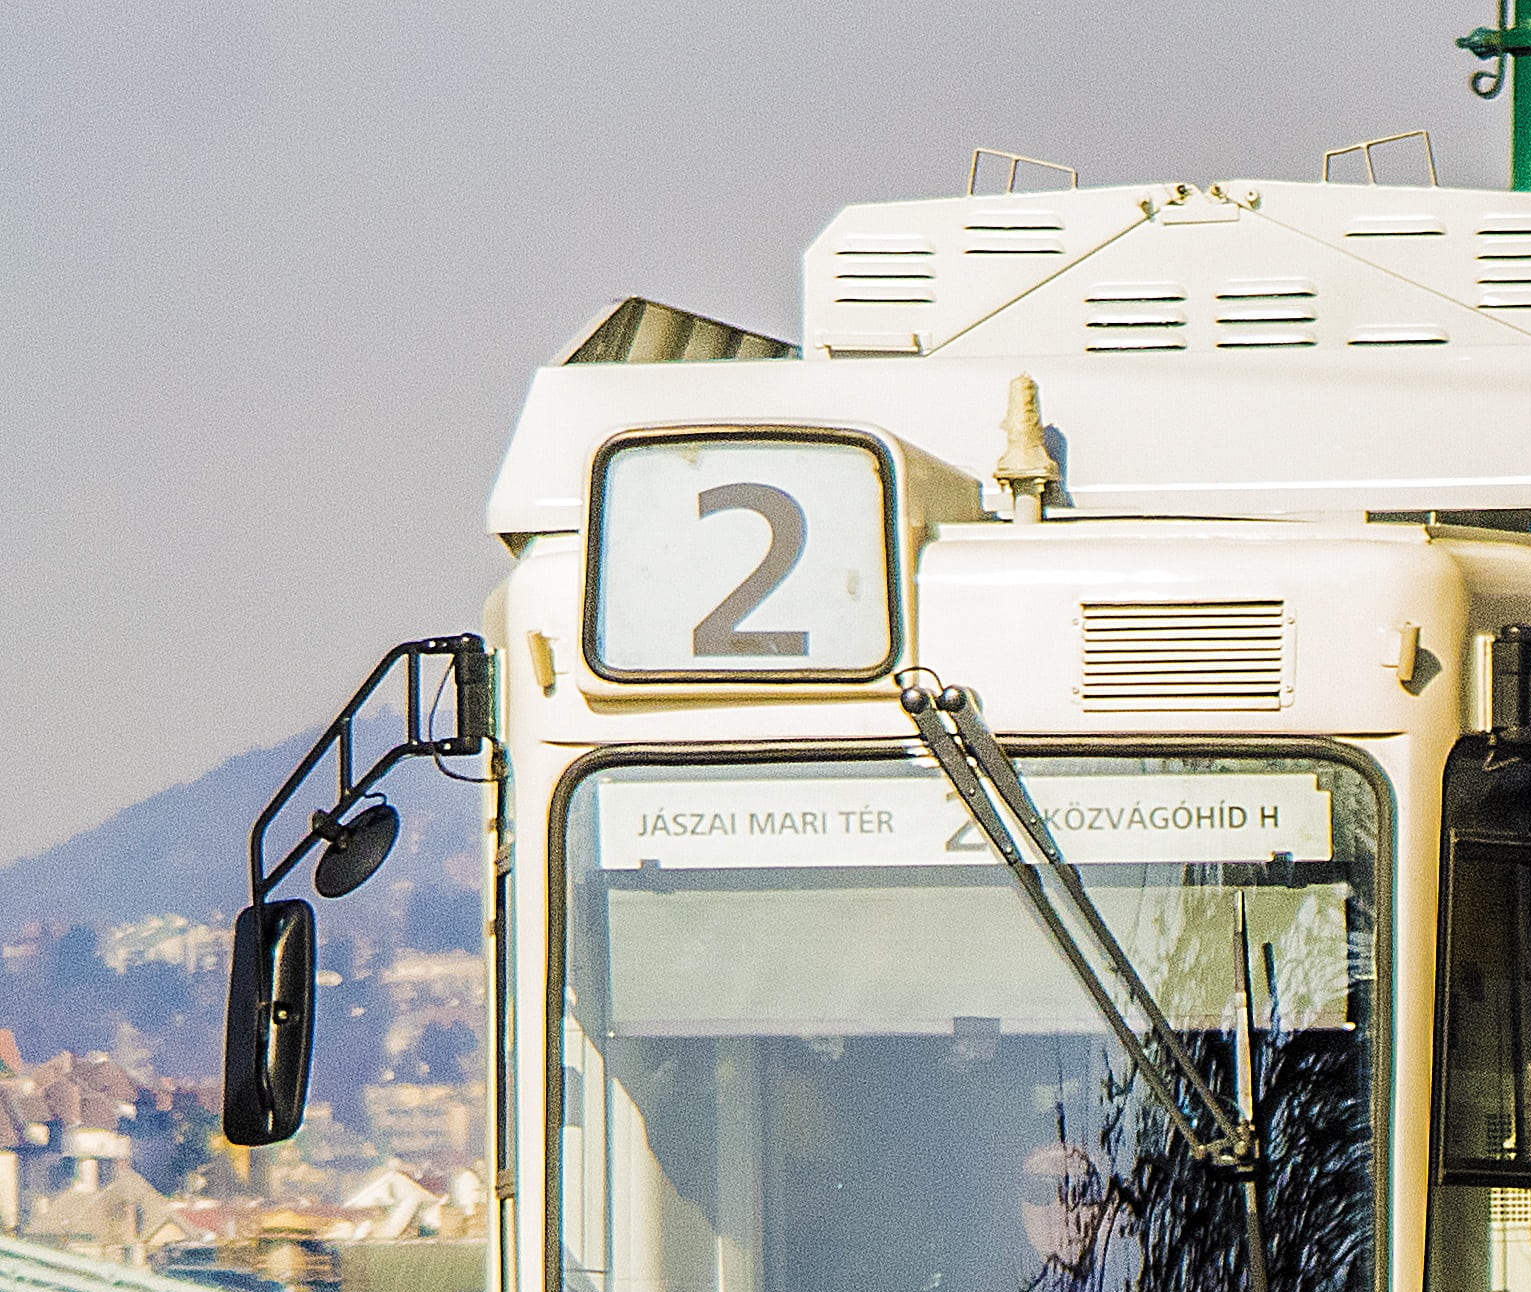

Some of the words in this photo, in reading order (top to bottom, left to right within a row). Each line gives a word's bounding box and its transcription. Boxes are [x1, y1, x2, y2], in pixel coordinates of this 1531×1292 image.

[693, 482, 810, 657] 2
[638, 806, 737, 837] JÁSZAI
[749, 811, 827, 835] MARI
[838, 805, 895, 833] TÉR
[1044, 800, 1247, 832] KÖZVÁGÓHÍD
[1260, 806, 1280, 828] H
